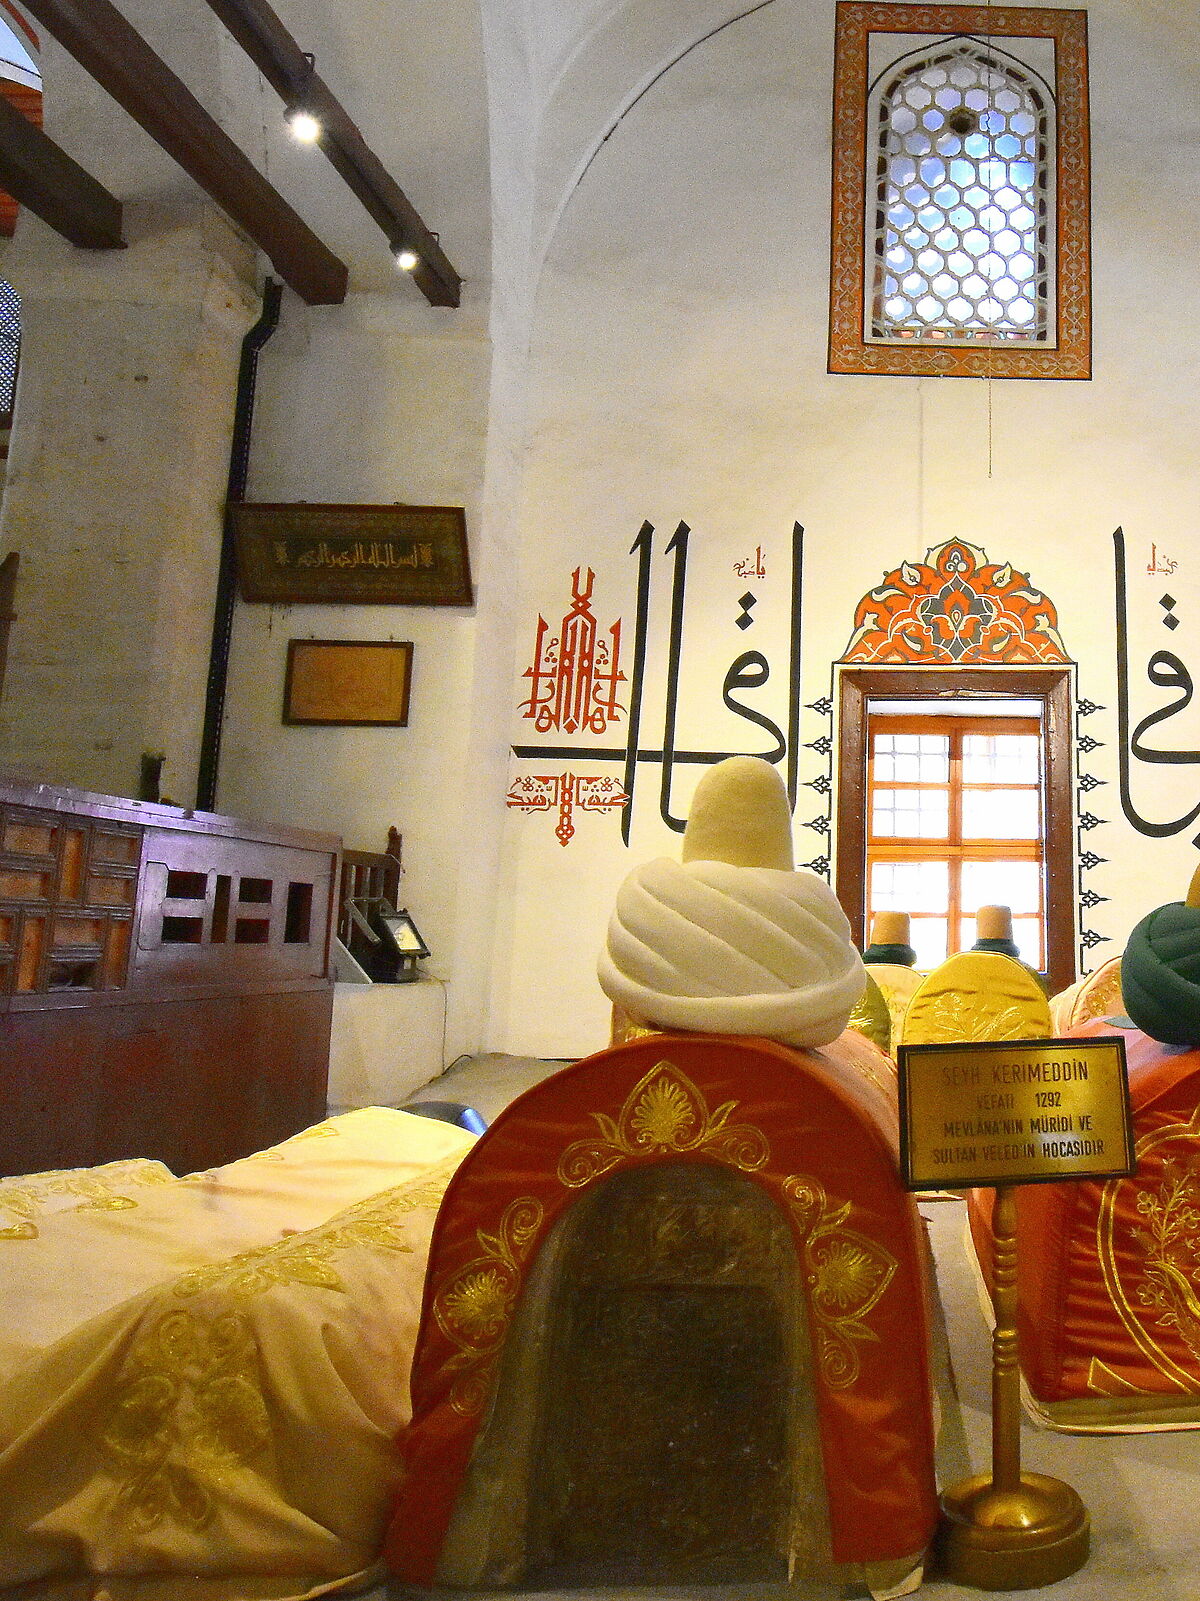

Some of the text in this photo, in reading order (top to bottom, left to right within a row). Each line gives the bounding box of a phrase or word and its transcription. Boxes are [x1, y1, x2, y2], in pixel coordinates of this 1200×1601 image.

[992, 1058, 1089, 1085] KERİMEDDİN
[1035, 1091, 1062, 1108] 1292
[1030, 1114, 1073, 1134] MÜRİDİ
[1078, 1115, 1093, 1131] VE
[932, 1147, 977, 1164] SULTAN
[1042, 1139, 1105, 1159] HOCASIDIR
